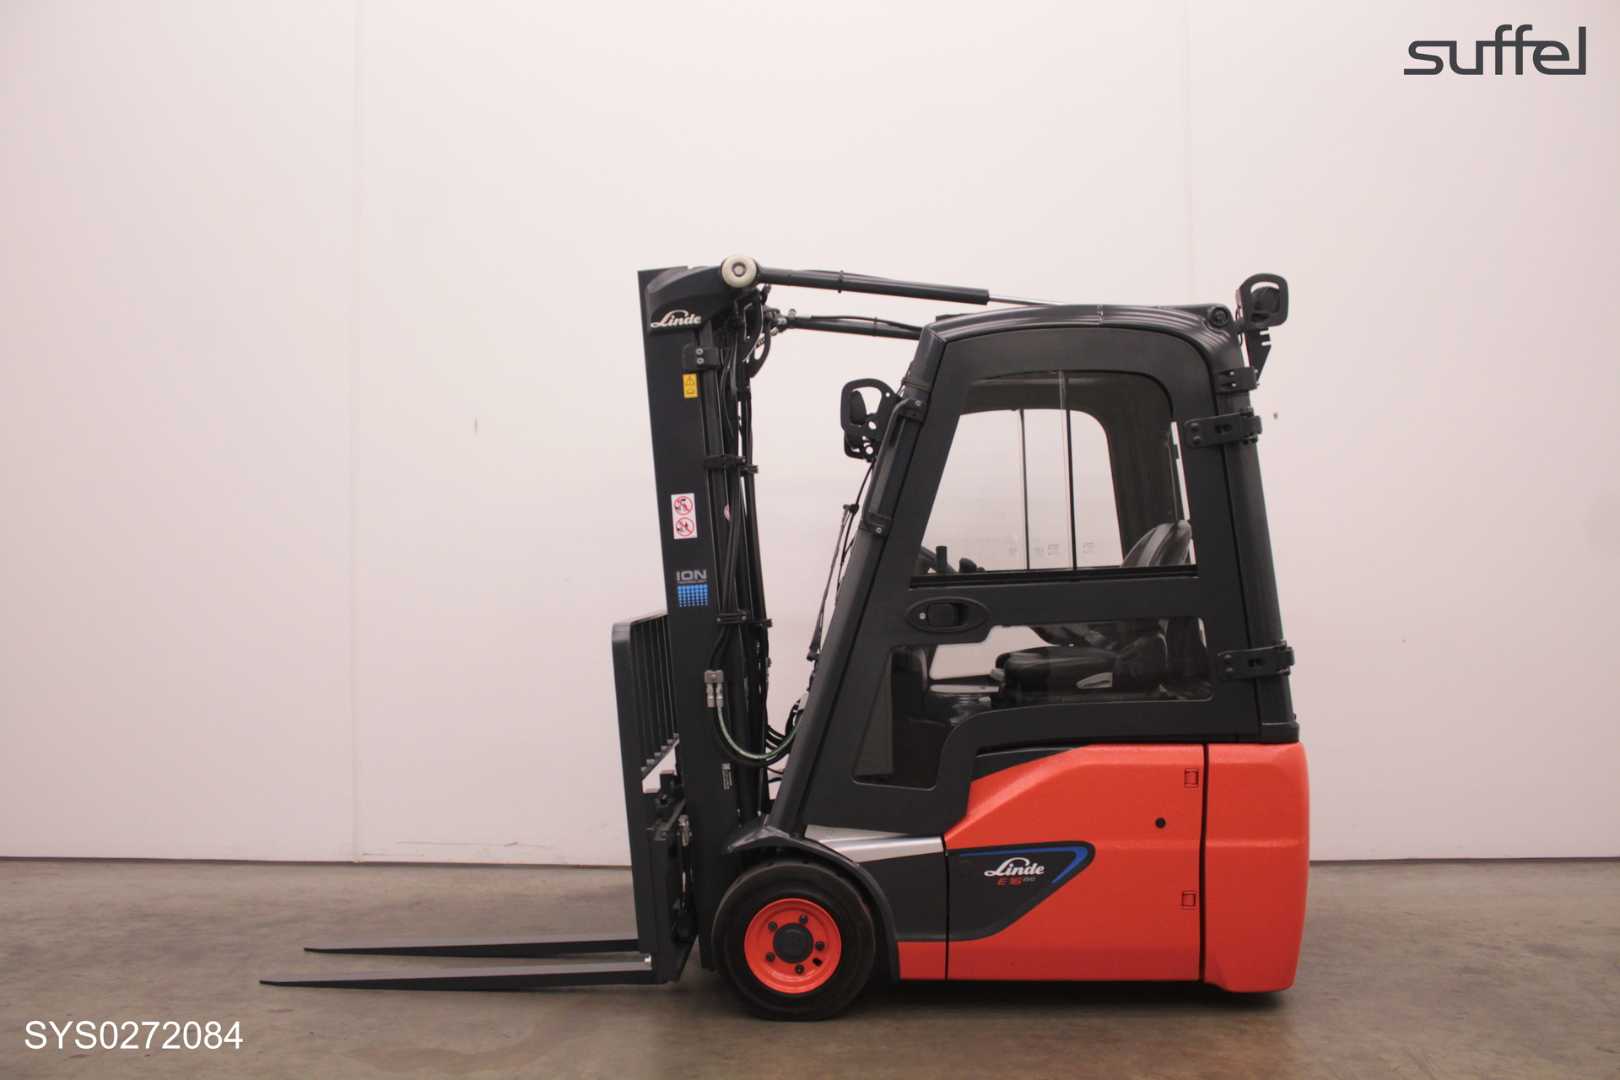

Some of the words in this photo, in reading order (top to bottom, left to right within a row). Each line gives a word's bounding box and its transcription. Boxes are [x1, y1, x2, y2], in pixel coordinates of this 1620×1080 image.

[650, 309, 702, 328] Linde
[676, 569, 708, 581] ION
[984, 857, 1045, 876] Linde
